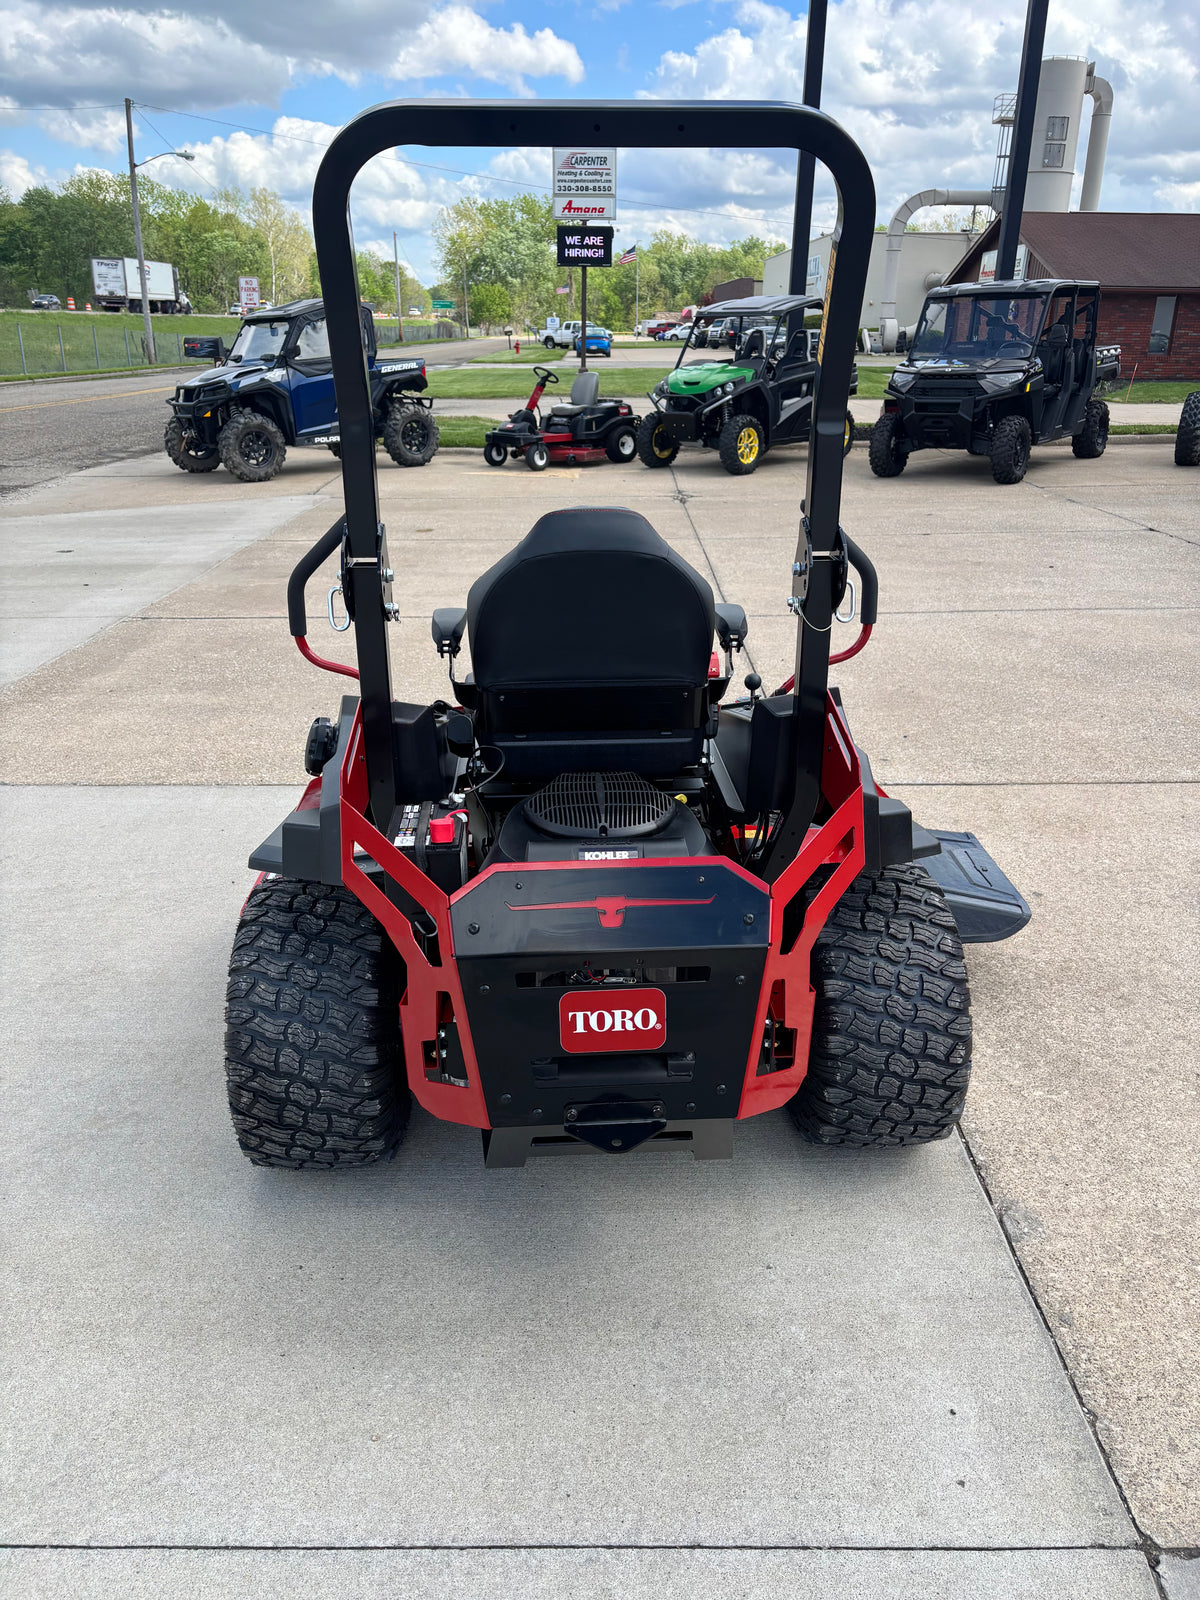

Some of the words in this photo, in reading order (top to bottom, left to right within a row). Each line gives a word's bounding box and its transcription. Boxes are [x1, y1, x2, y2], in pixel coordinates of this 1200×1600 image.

[570, 156, 608, 166] CARPENTER
[562, 200, 605, 213] Amana
[565, 236, 581, 245] WE
[583, 236, 604, 246] ARE
[565, 248, 604, 258] HIRING!!
[380, 362, 419, 374] GENERAL
[584, 850, 630, 861] KOHLER
[568, 1008, 658, 1034] TORO
